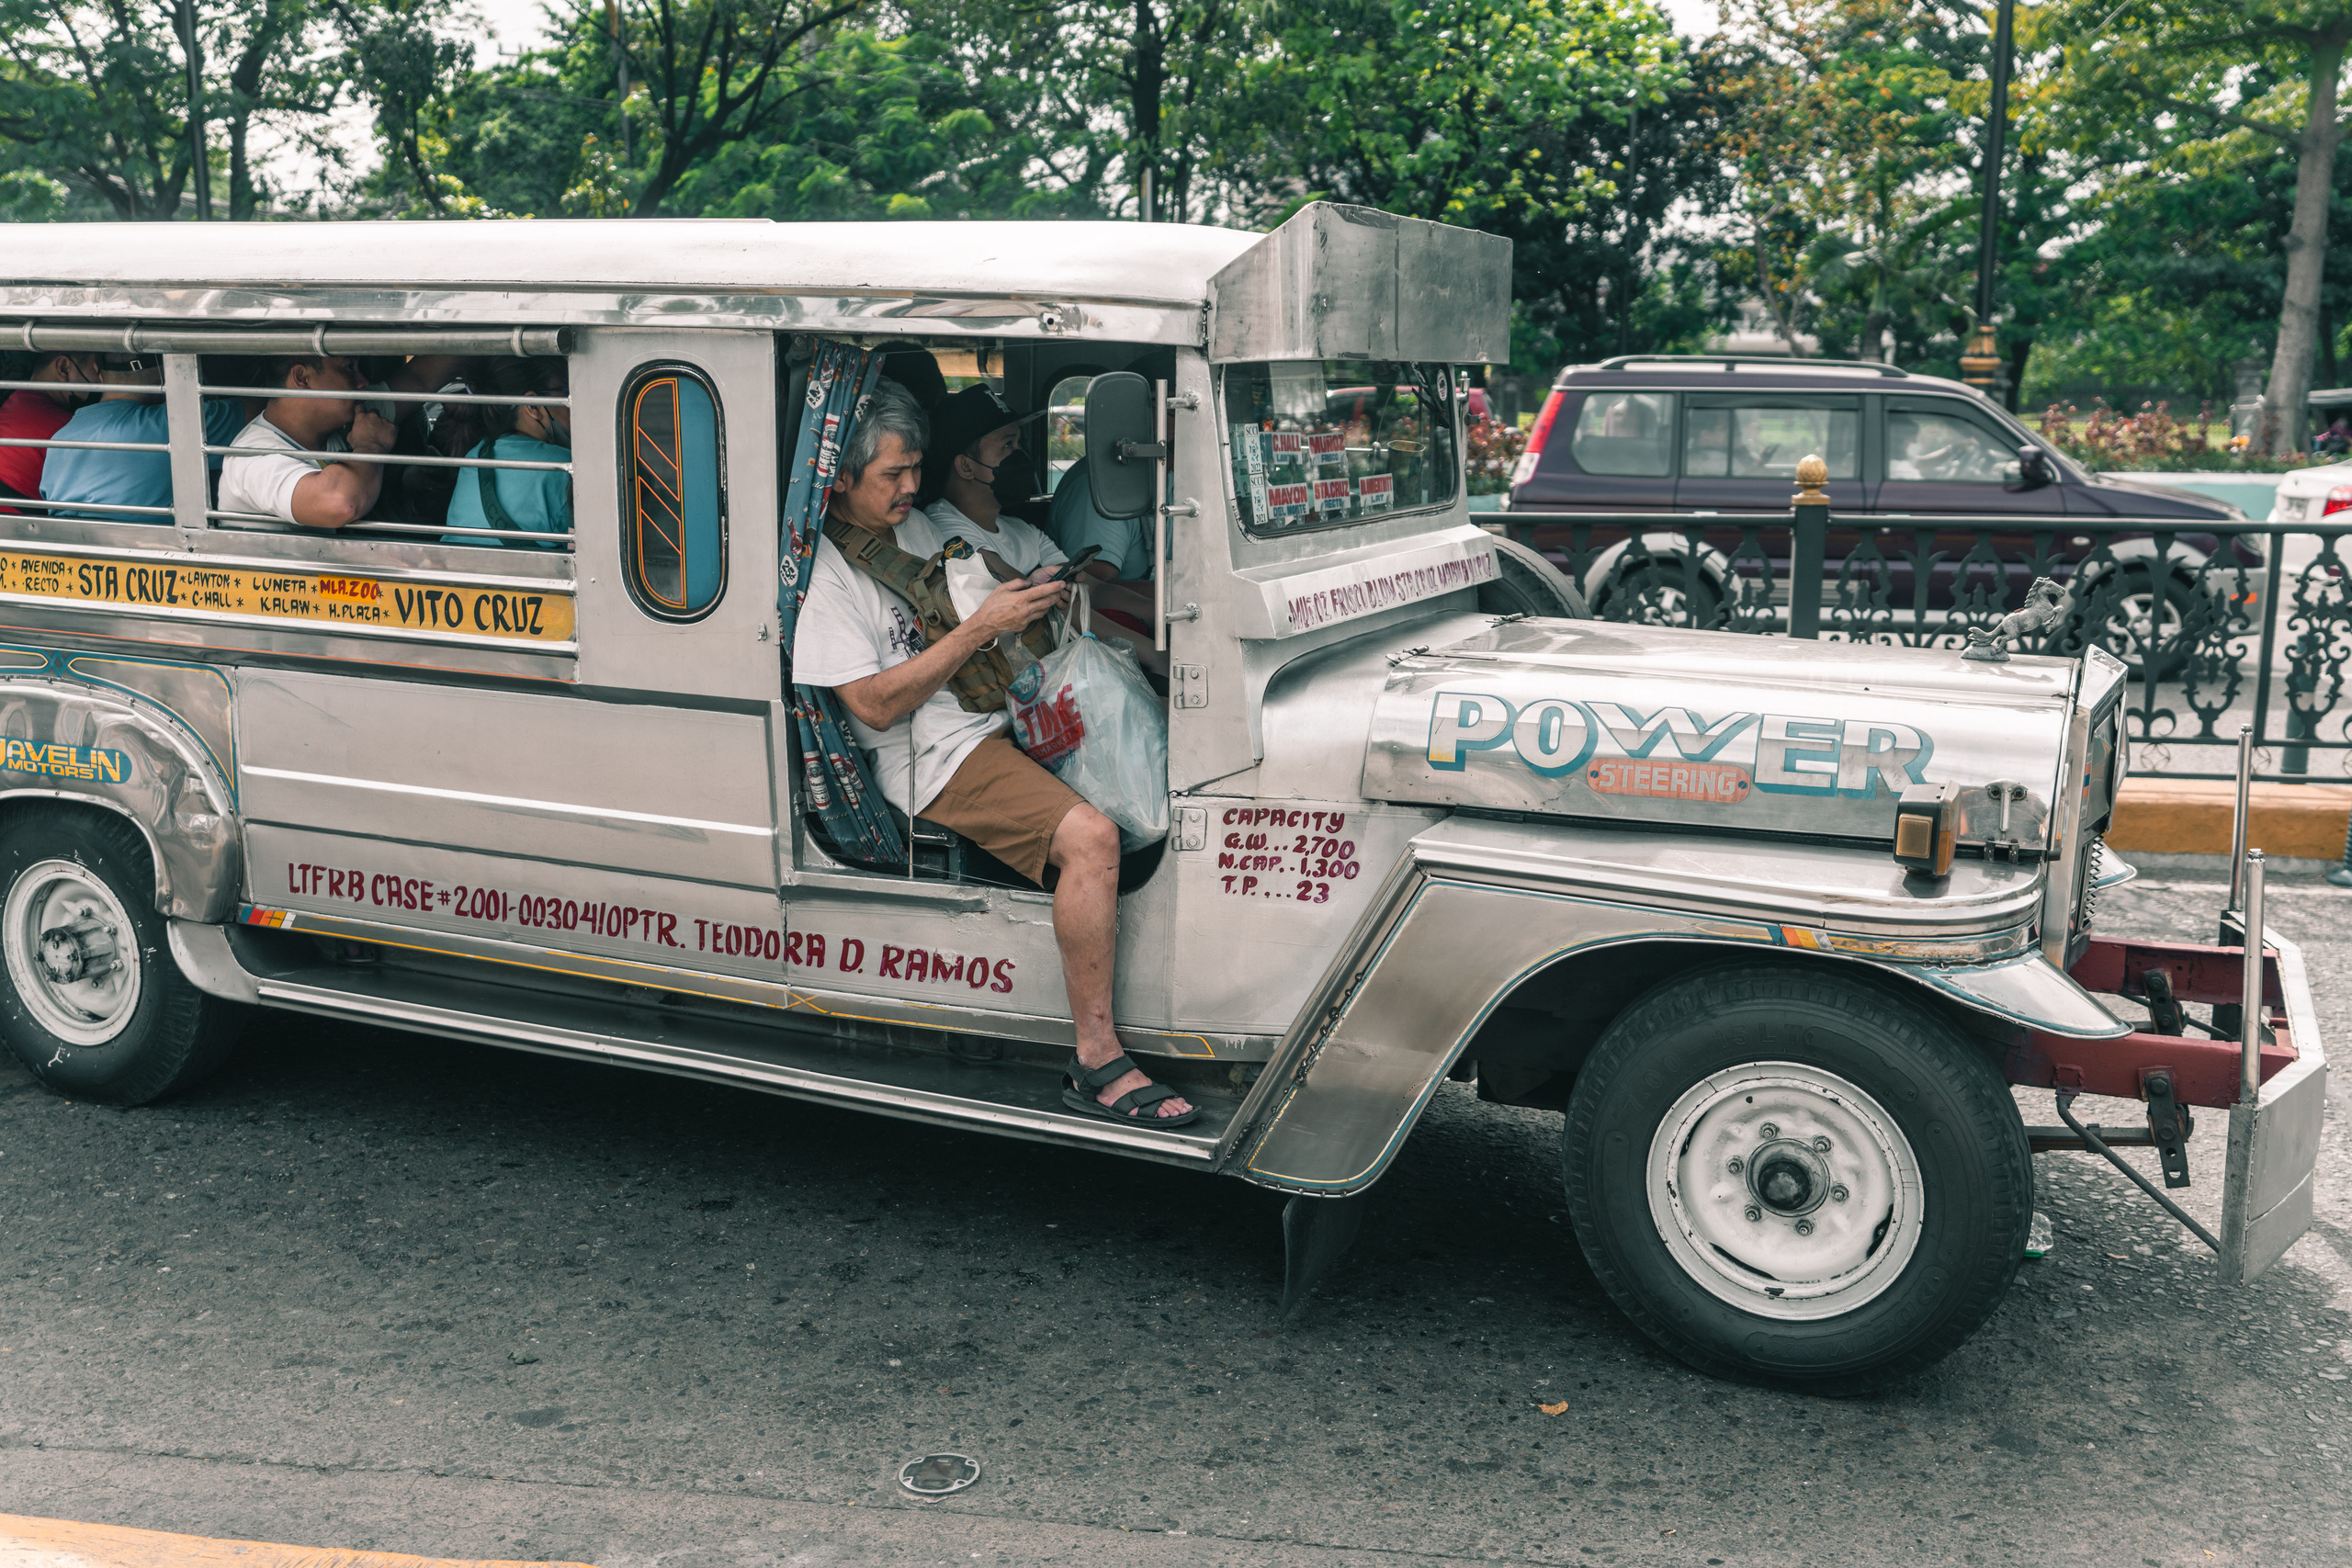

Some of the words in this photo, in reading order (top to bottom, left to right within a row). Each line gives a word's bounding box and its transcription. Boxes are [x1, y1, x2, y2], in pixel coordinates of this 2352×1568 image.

[1272, 434, 1301, 452] C.HALL
[1309, 434, 1345, 454] MUÑOZ
[1268, 486, 1308, 506] MAYON
[1371, 494, 1384, 503] LRT
[1273, 506, 1286, 516] DEL
[20, 558, 65, 577] AVENIDA
[78, 563, 118, 601] STA
[125, 568, 178, 604] CRUZ
[187, 571, 231, 590] LAWTON
[253, 577, 306, 595] LUNETA
[192, 590, 232, 608] C-HALL
[261, 597, 311, 615] KALAW
[394, 588, 464, 628] VITO
[474, 593, 544, 635] CRUZ
[1426, 690, 1934, 800] POWER
[7, 758, 94, 780] MOTORS
[1600, 763, 1736, 795] STEERING
[1222, 808, 1345, 834] CAPACITY
[288, 862, 365, 902] LTFRB
[695, 919, 826, 968] TEODORA
[840, 938, 864, 975] D.
[879, 942, 1016, 994] RAMOS
